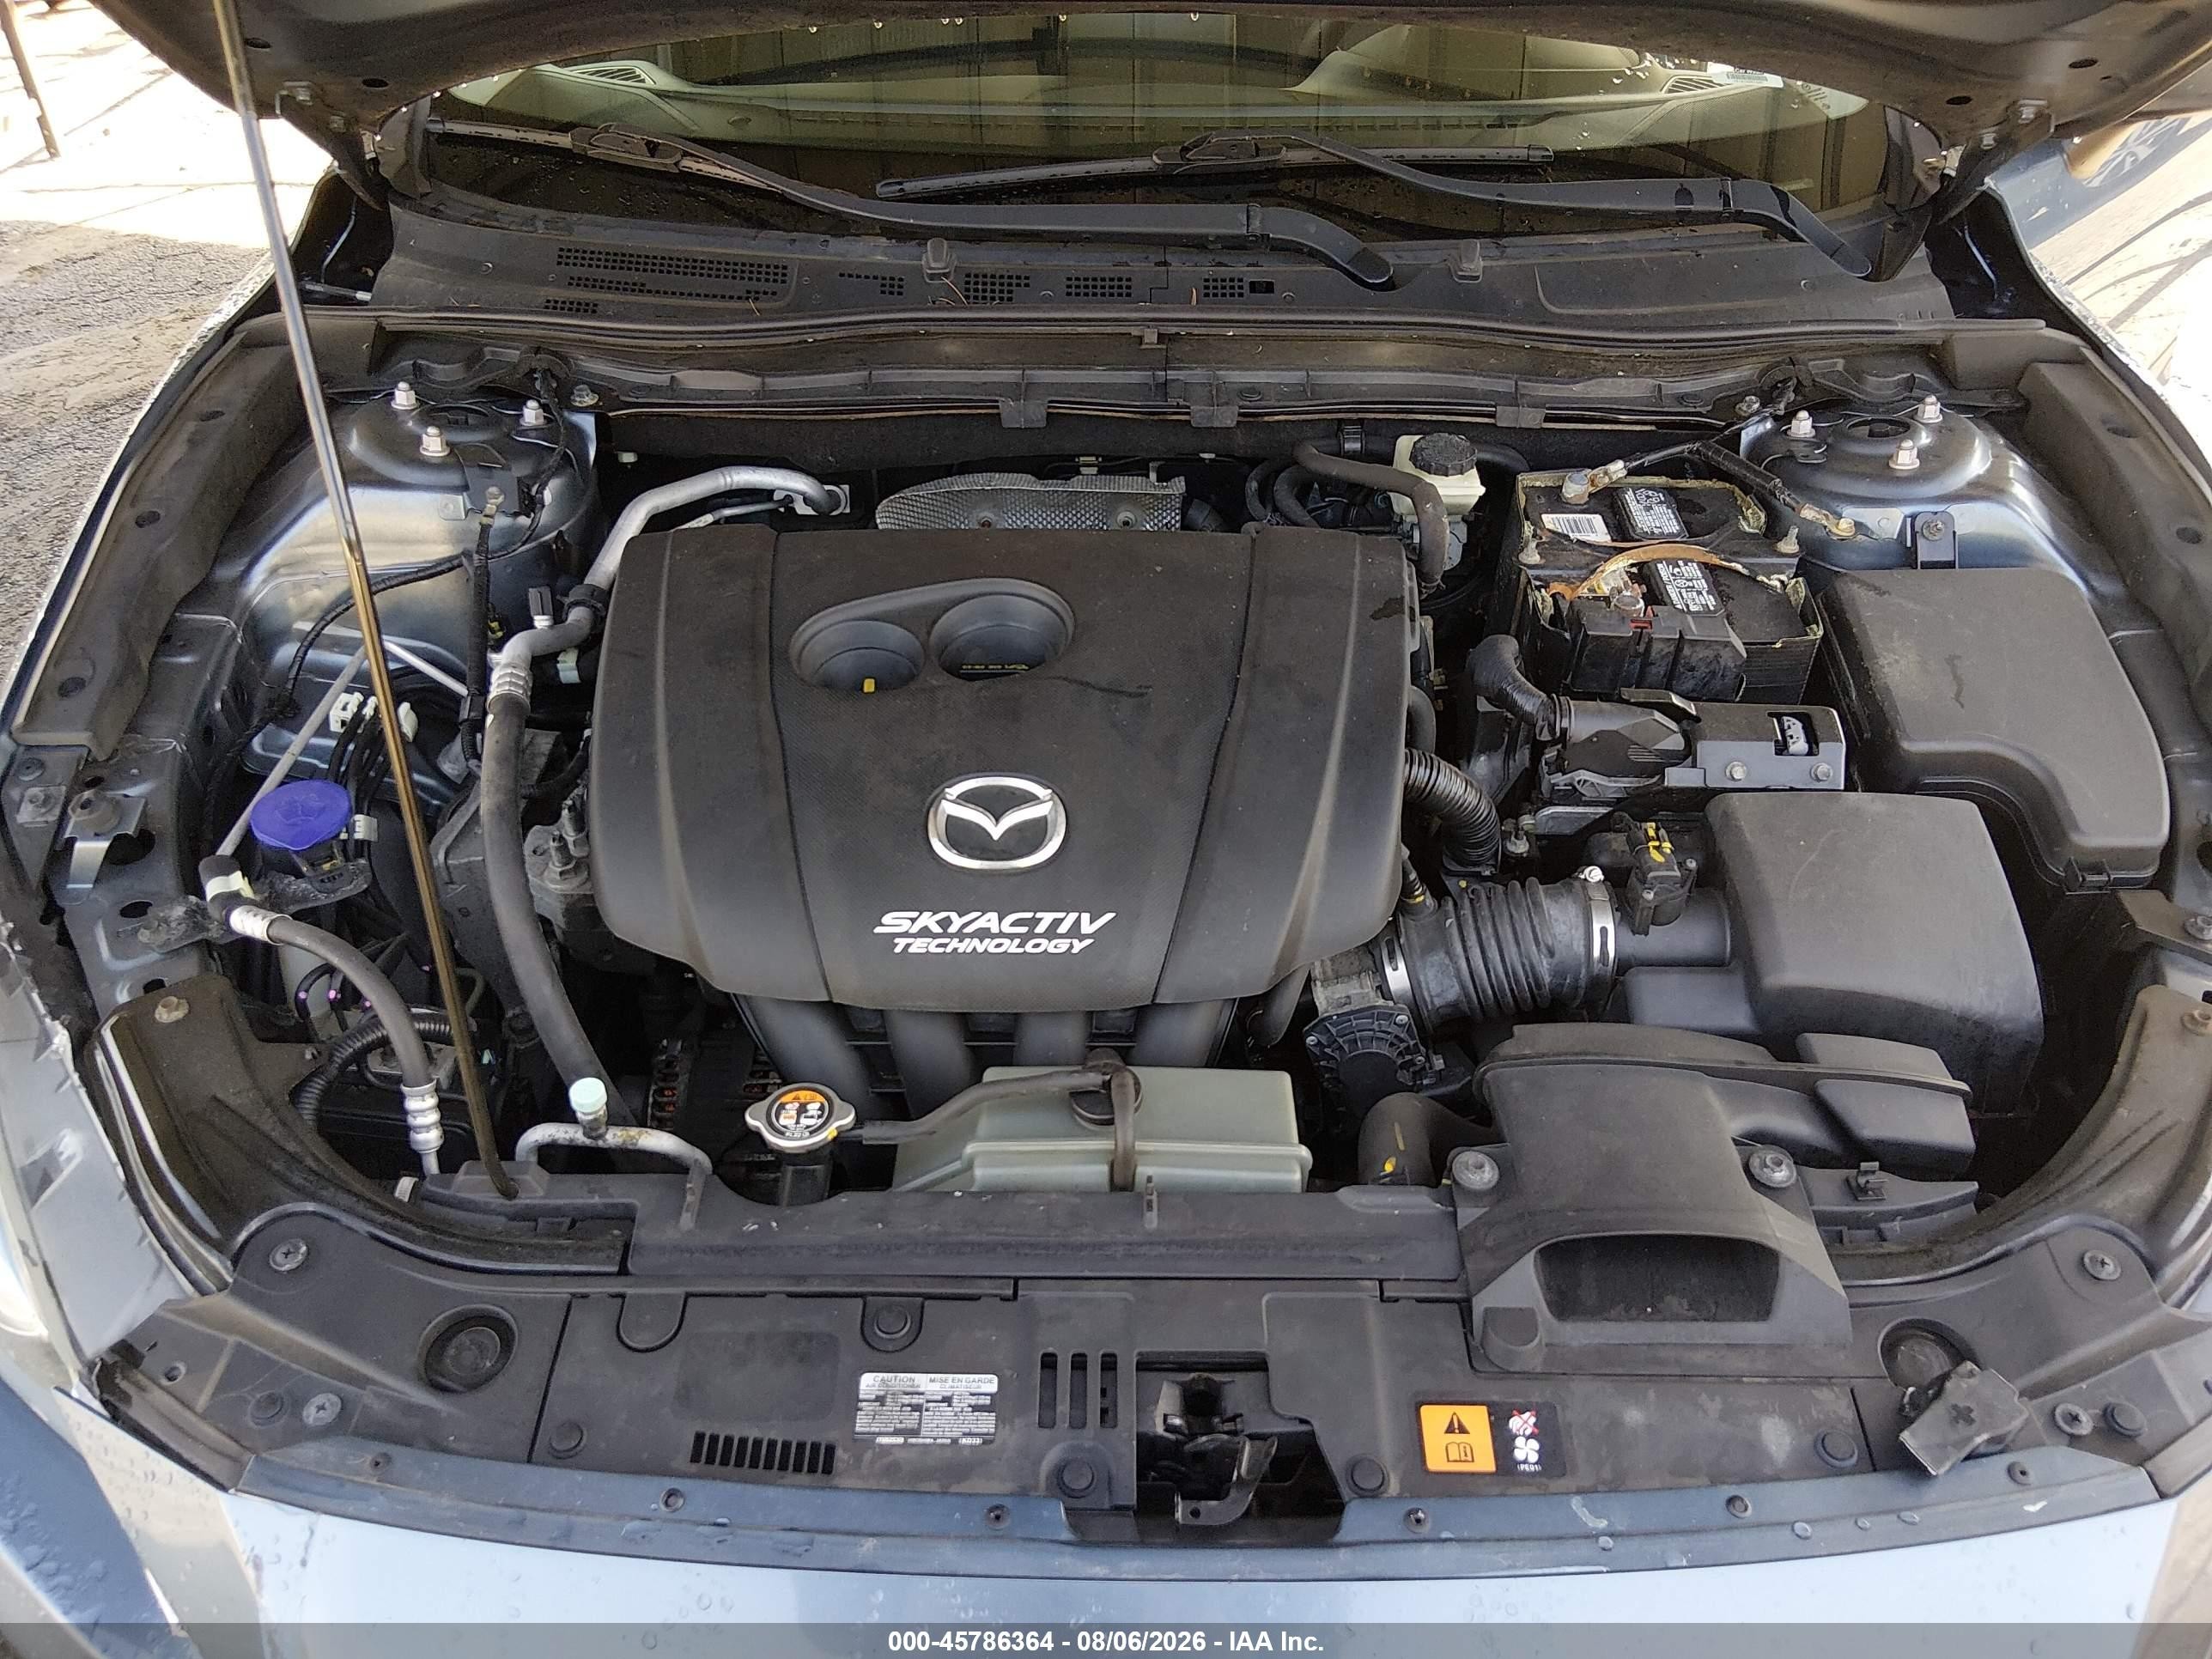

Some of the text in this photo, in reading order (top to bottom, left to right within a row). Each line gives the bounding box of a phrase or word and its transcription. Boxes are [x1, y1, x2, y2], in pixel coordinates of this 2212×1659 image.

[873, 911, 1116, 934] SKYACTIV
[893, 938, 1095, 954] TECHNOLOGY
[872, 1375, 916, 1383] CAUTION
